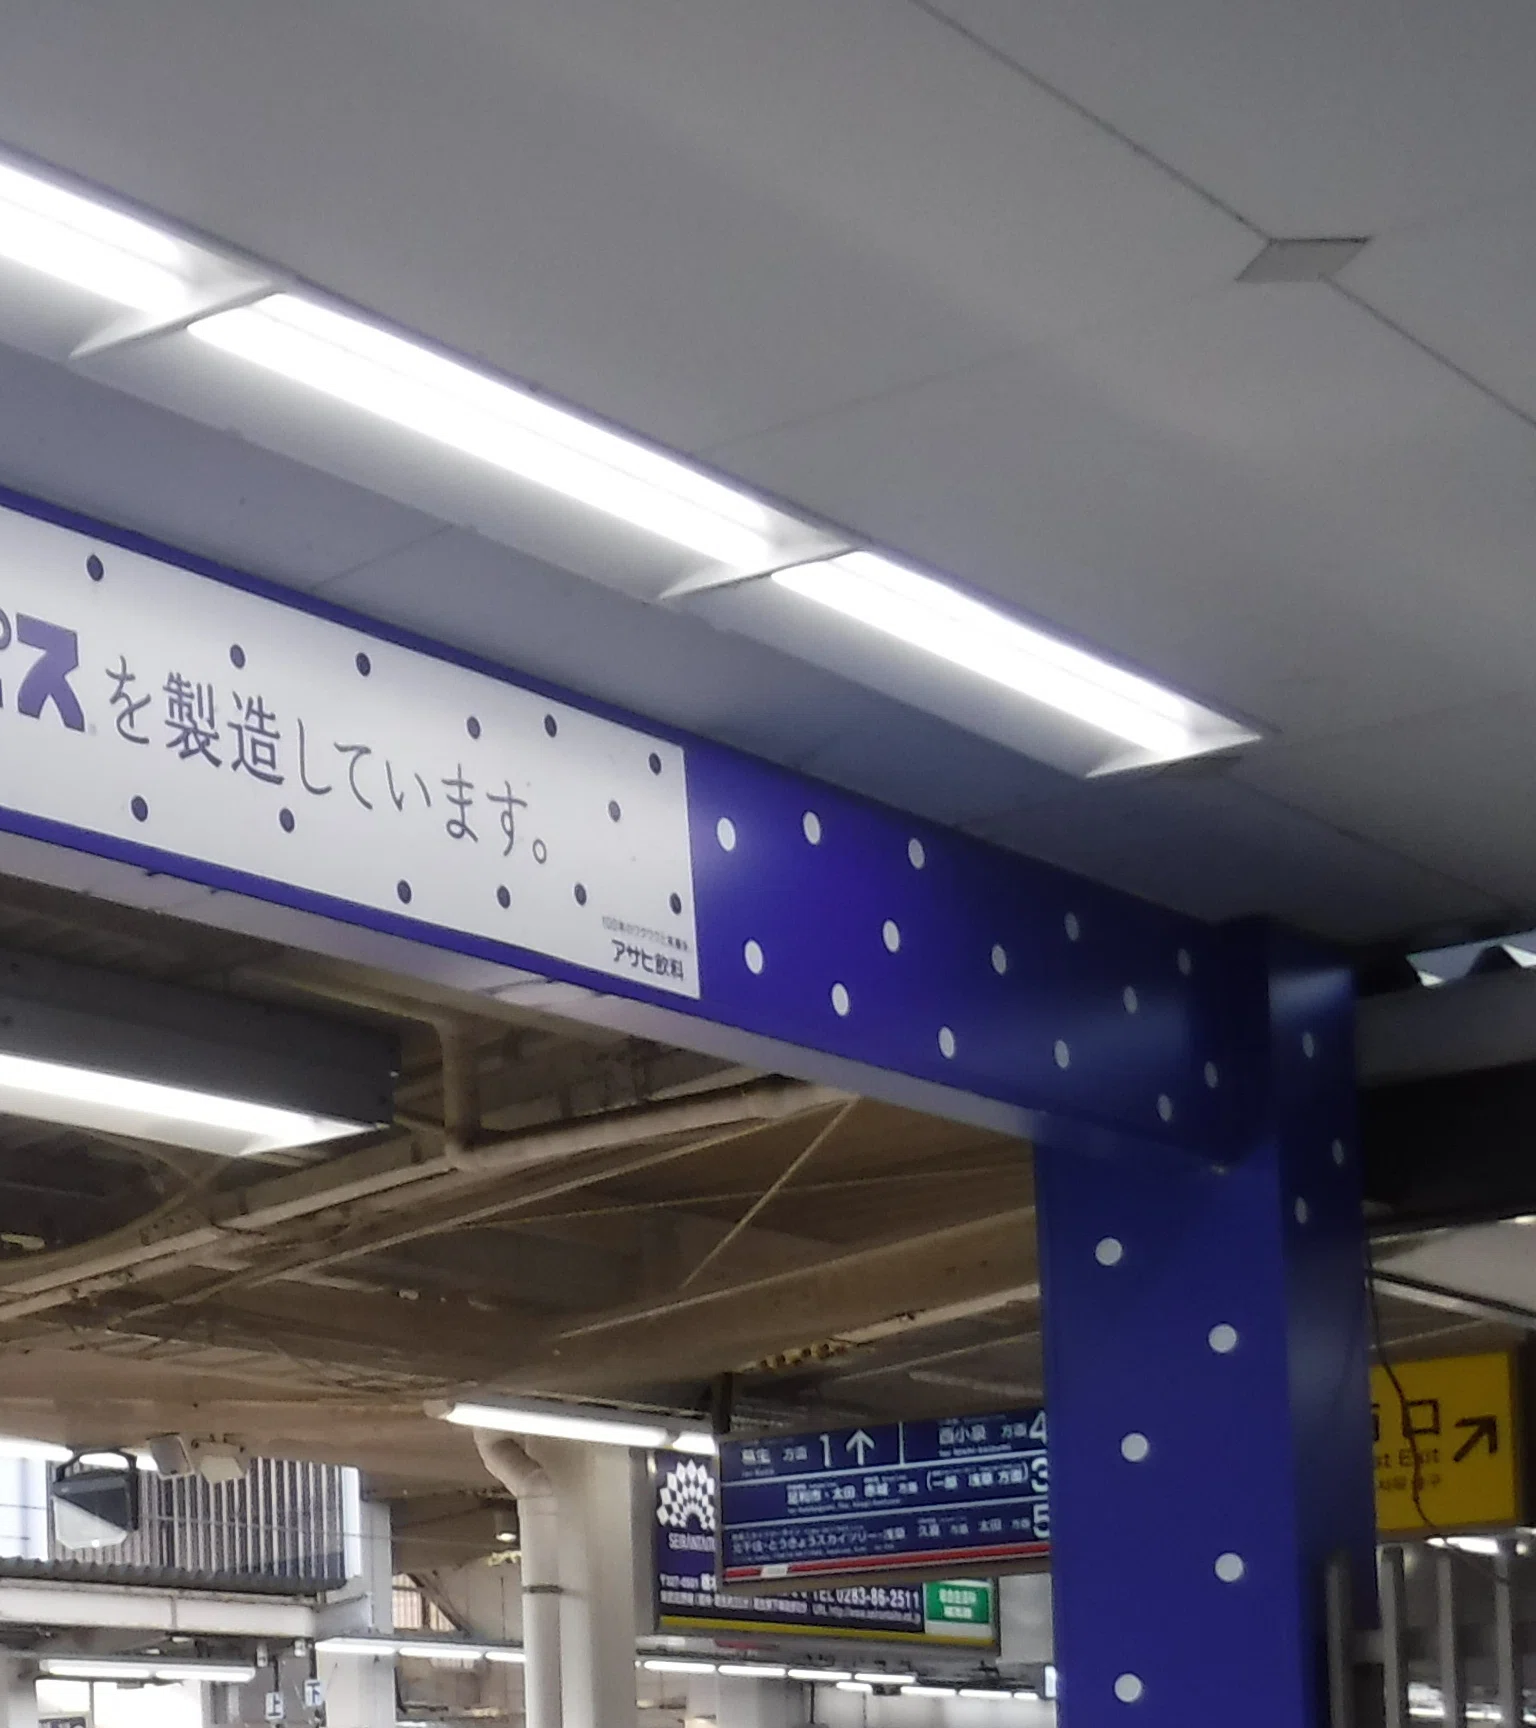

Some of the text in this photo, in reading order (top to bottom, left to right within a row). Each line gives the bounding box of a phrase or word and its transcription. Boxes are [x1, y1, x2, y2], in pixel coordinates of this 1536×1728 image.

[611, 938, 684, 981] アサヒ飲料
[820, 1432, 832, 1468] 1
[1028, 1410, 1048, 1444] 4
[1031, 1456, 1049, 1493] 3
[1033, 1502, 1049, 1539] 5
